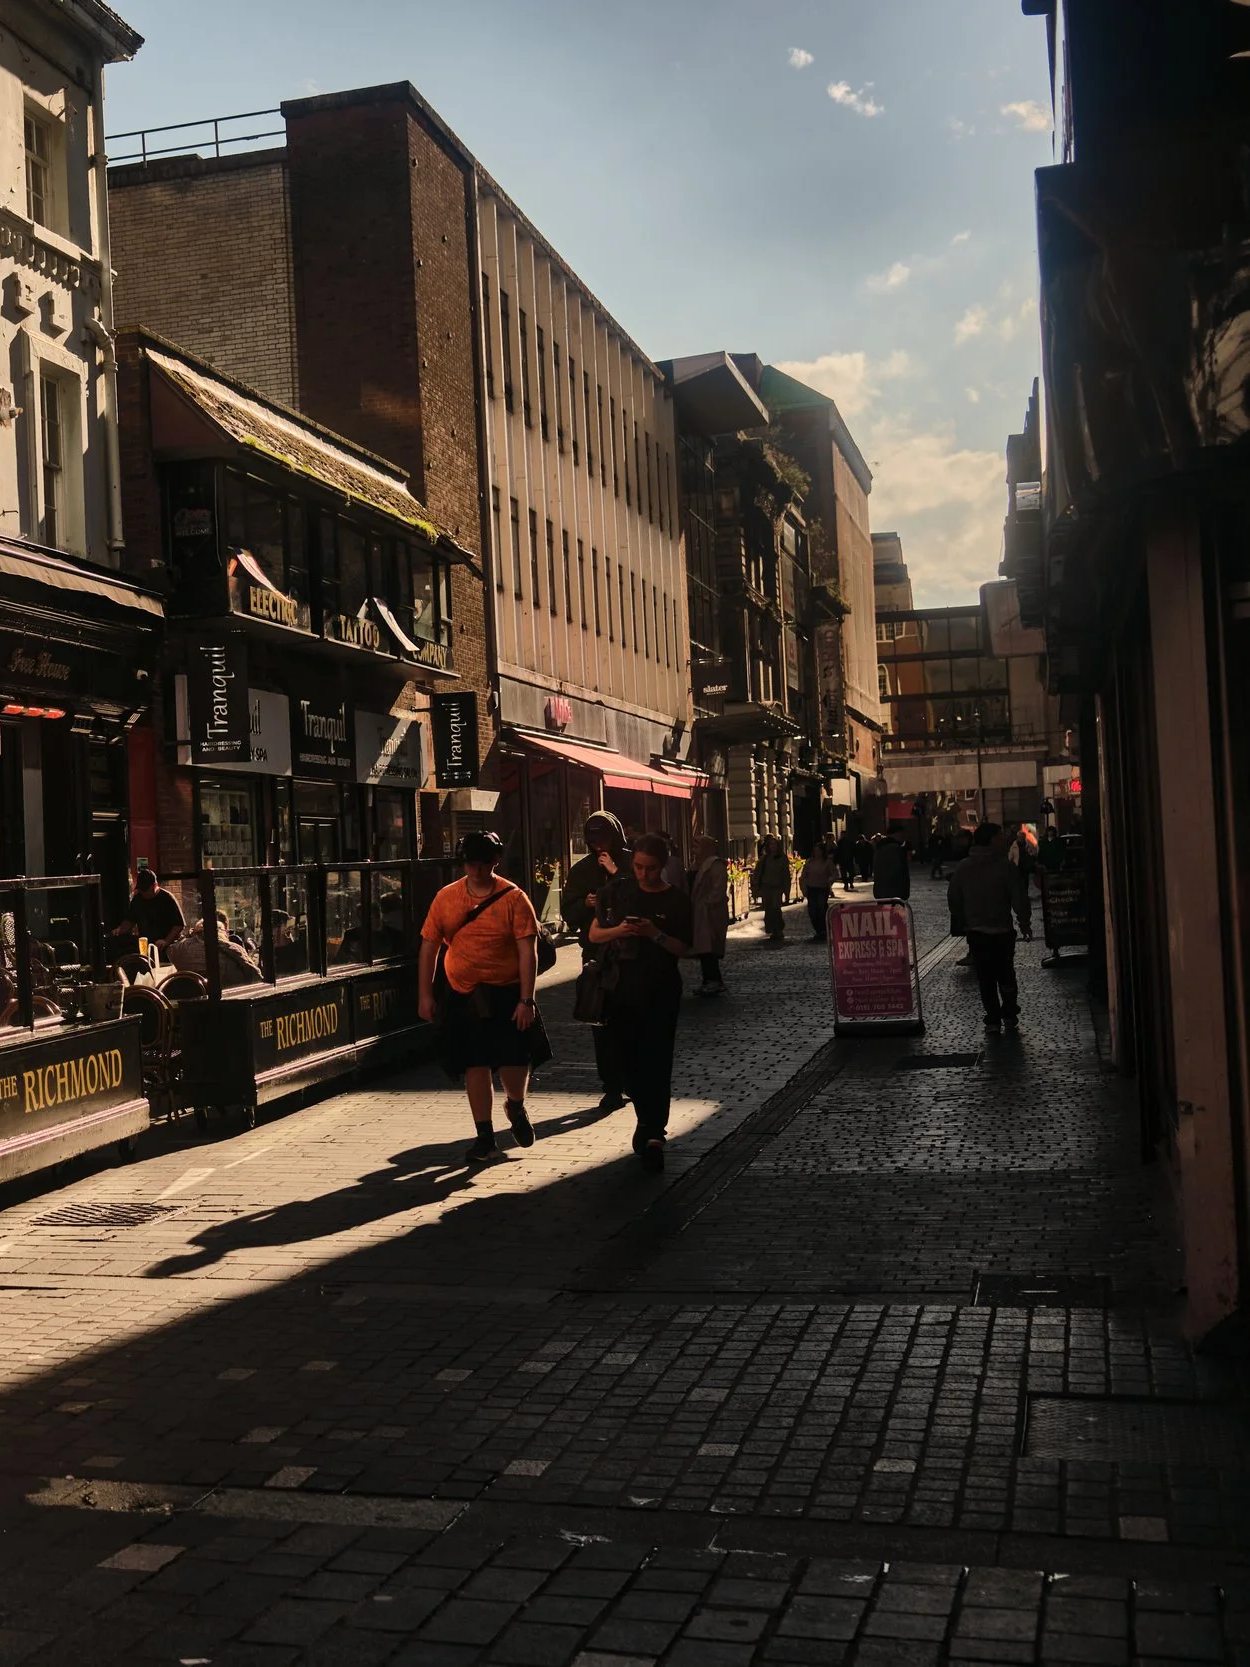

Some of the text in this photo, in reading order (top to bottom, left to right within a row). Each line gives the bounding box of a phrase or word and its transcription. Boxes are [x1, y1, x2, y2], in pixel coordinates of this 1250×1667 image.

[339, 614, 381, 648] TATTOO
[199, 645, 235, 740] Tranquil
[300, 700, 347, 754] Tranquil
[441, 702, 467, 770] Tranquil
[837, 940, 877, 960] EXPRESS
[886, 938, 905, 957] SPA
[840, 911, 898, 938] NAIL
[260, 1003, 338, 1050] THE RICHMOND
[23, 1048, 123, 1114] RICHMOND
